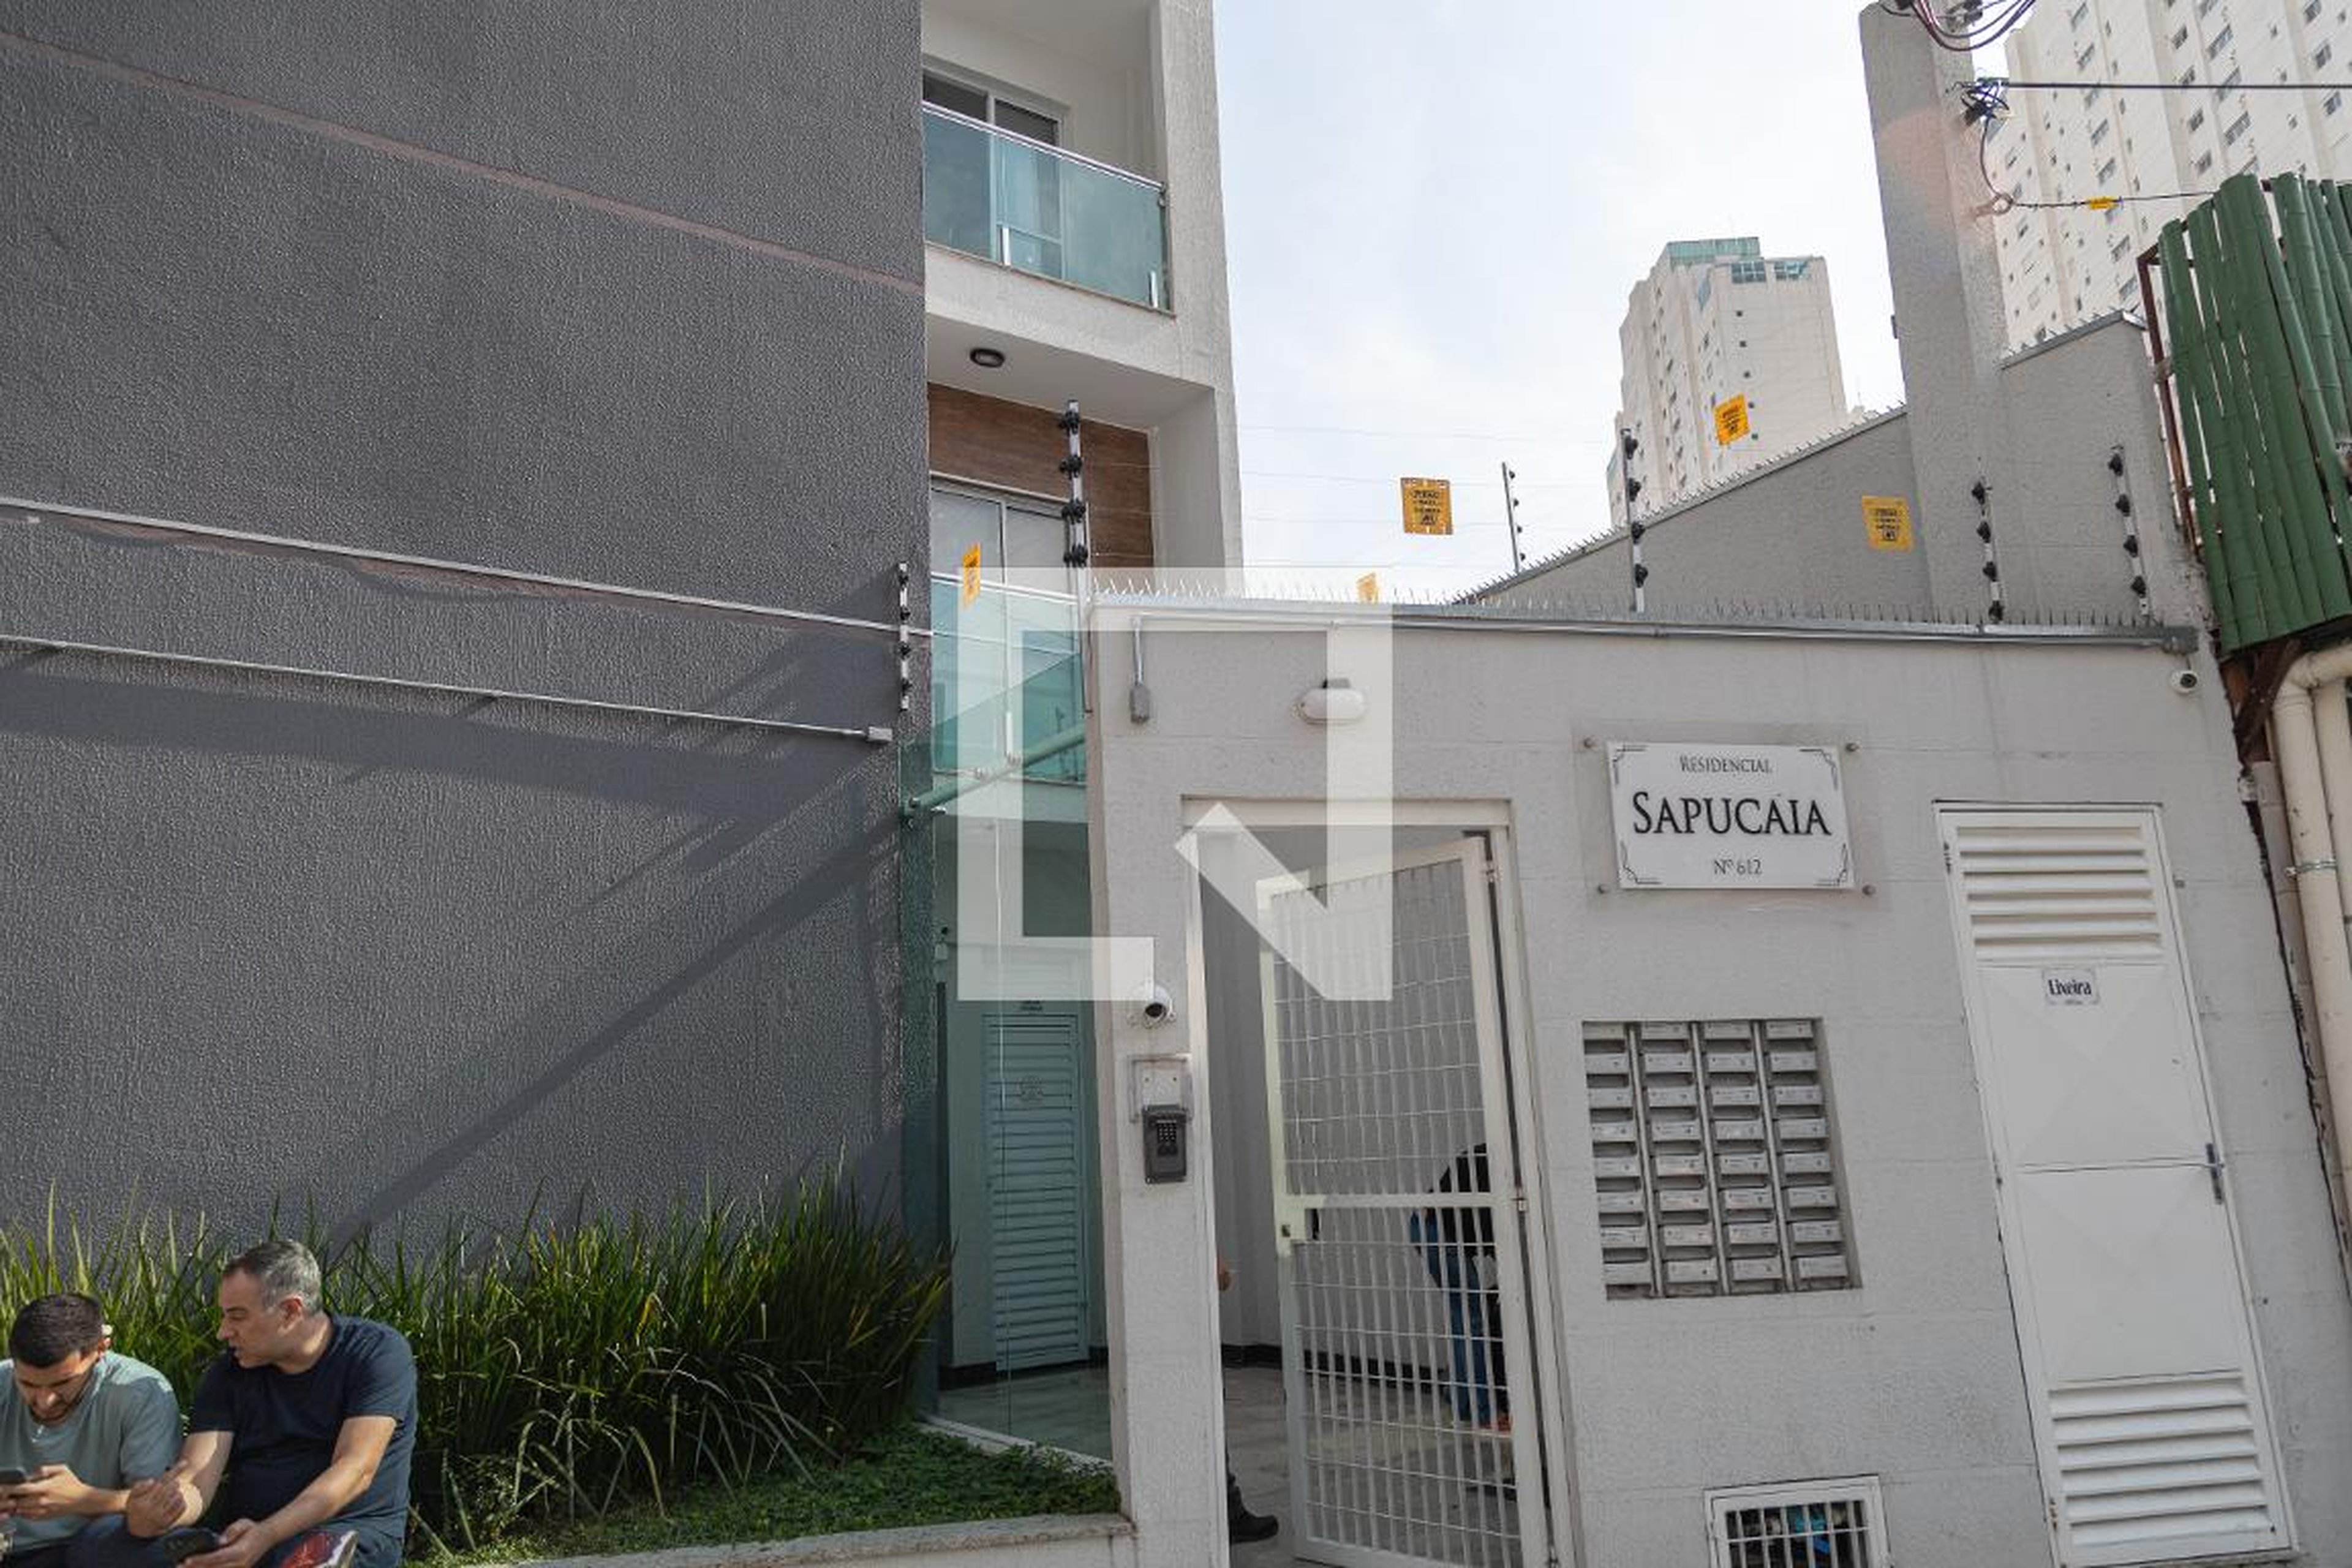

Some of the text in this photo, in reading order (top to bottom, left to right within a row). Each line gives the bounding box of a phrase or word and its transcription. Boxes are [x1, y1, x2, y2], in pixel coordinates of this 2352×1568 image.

[1679, 755, 1773, 774] RESIDENCIAL
[1736, 859, 1763, 876] 612
[2048, 979, 2092, 995] Lixeira
